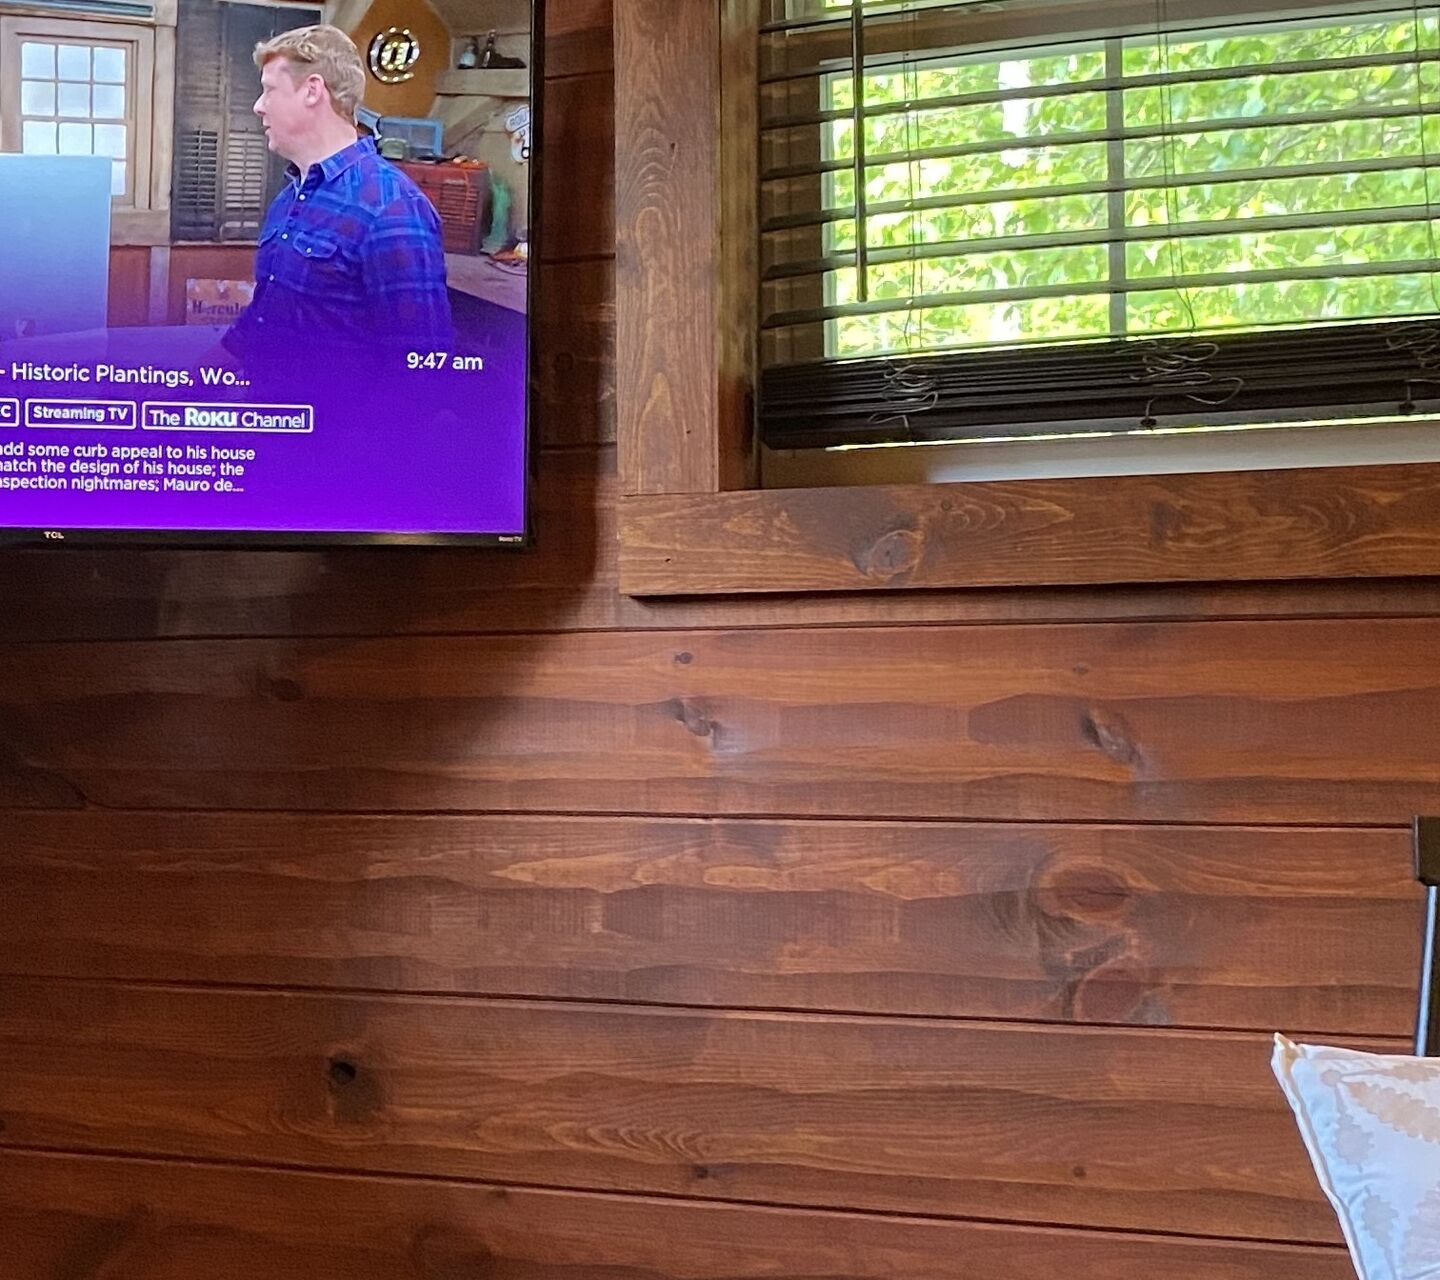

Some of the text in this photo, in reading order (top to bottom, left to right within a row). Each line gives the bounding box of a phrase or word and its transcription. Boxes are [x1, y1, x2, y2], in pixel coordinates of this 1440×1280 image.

[407, 352, 483, 370] 9:47 am
[12, 362, 90, 382] Historic
[96, 364, 194, 387] Plantings,
[200, 367, 250, 386] Wo...
[33, 405, 128, 421] Streaming TV
[149, 409, 180, 426] The
[241, 411, 306, 428] Channel
[28, 444, 70, 457] some
[73, 443, 108, 458] curb
[111, 445, 162, 461] appeal
[166, 446, 183, 459] to
[186, 445, 208, 459] his
[210, 446, 256, 460] house
[40, 459, 66, 473] the
[69, 459, 120, 475] design
[123, 460, 140, 474] of
[143, 460, 164, 474] his
[167, 461, 216, 477] house;
[220, 462, 245, 476] the
[71, 476, 160, 491] nightmares;
[164, 477, 210, 492] Mauro
[214, 478, 245, 492] de...
[43, 531, 65, 539] TCL
